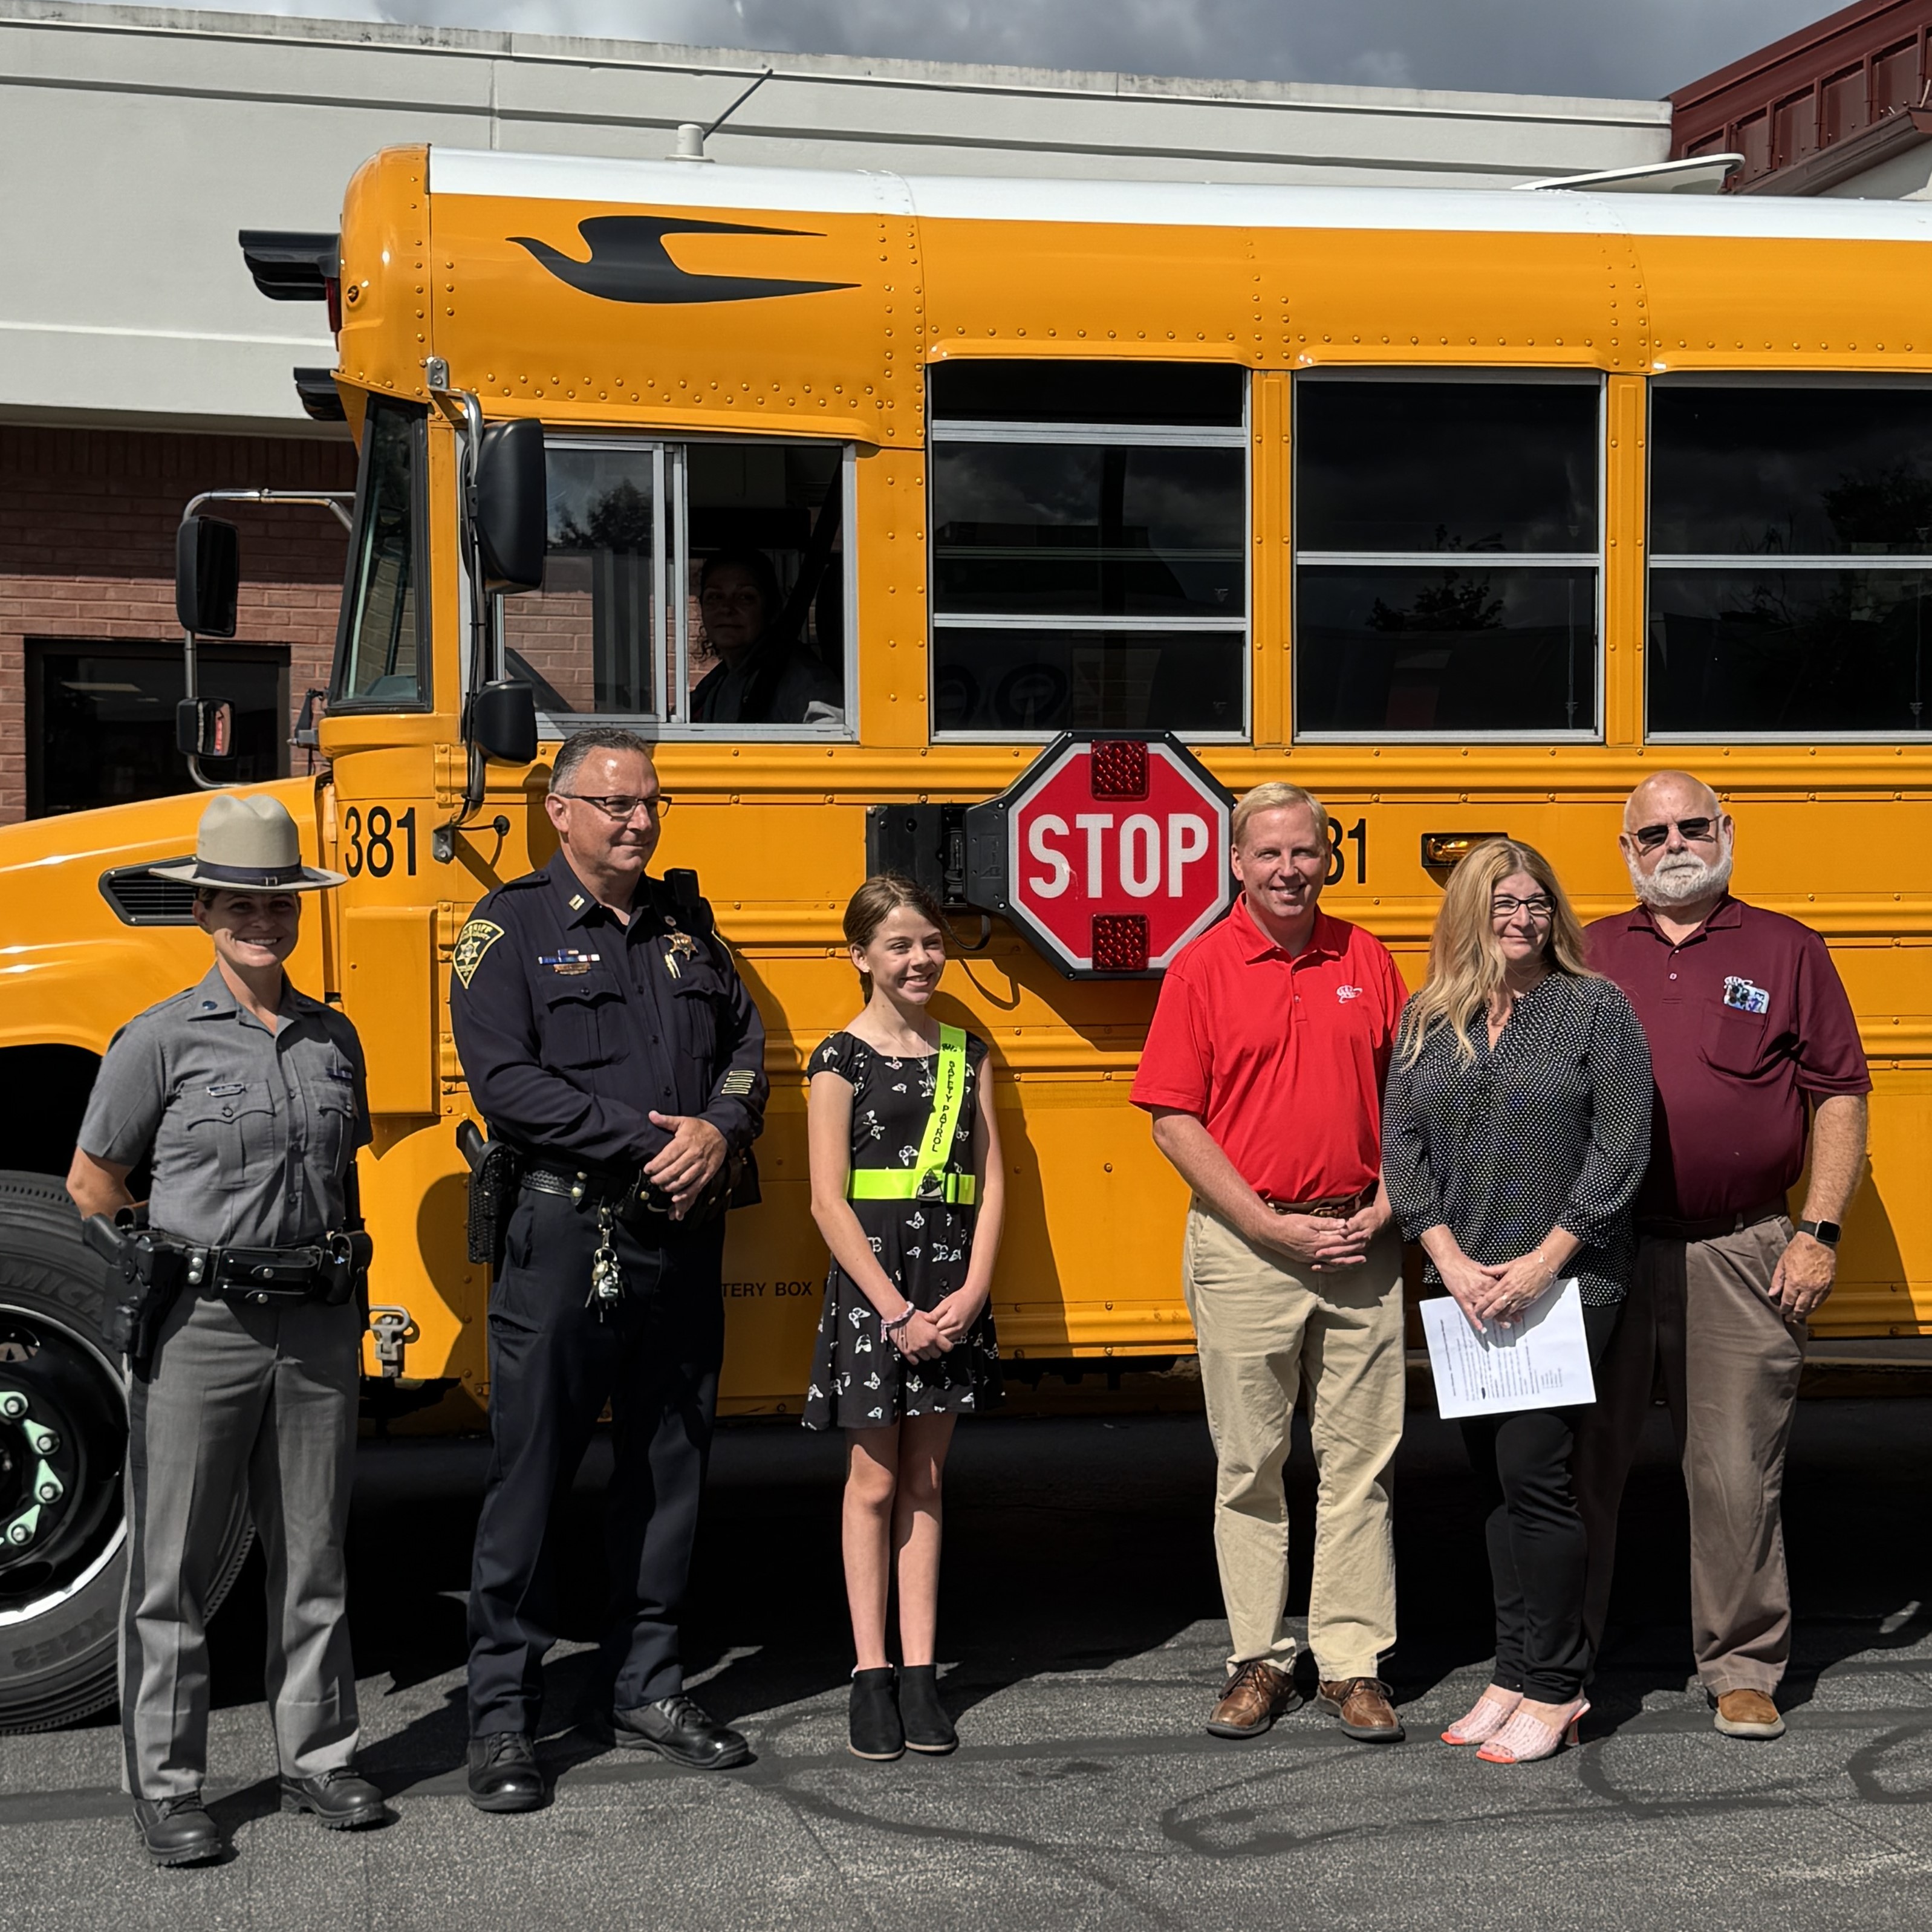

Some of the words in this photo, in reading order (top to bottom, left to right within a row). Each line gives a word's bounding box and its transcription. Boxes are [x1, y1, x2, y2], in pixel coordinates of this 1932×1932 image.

[345, 805, 417, 877] 381
[1028, 813, 1209, 899] STOP
[945, 1061, 955, 1103] SAFETY
[932, 1105, 949, 1153] PATROL
[775, 1281, 813, 1296] BOX
